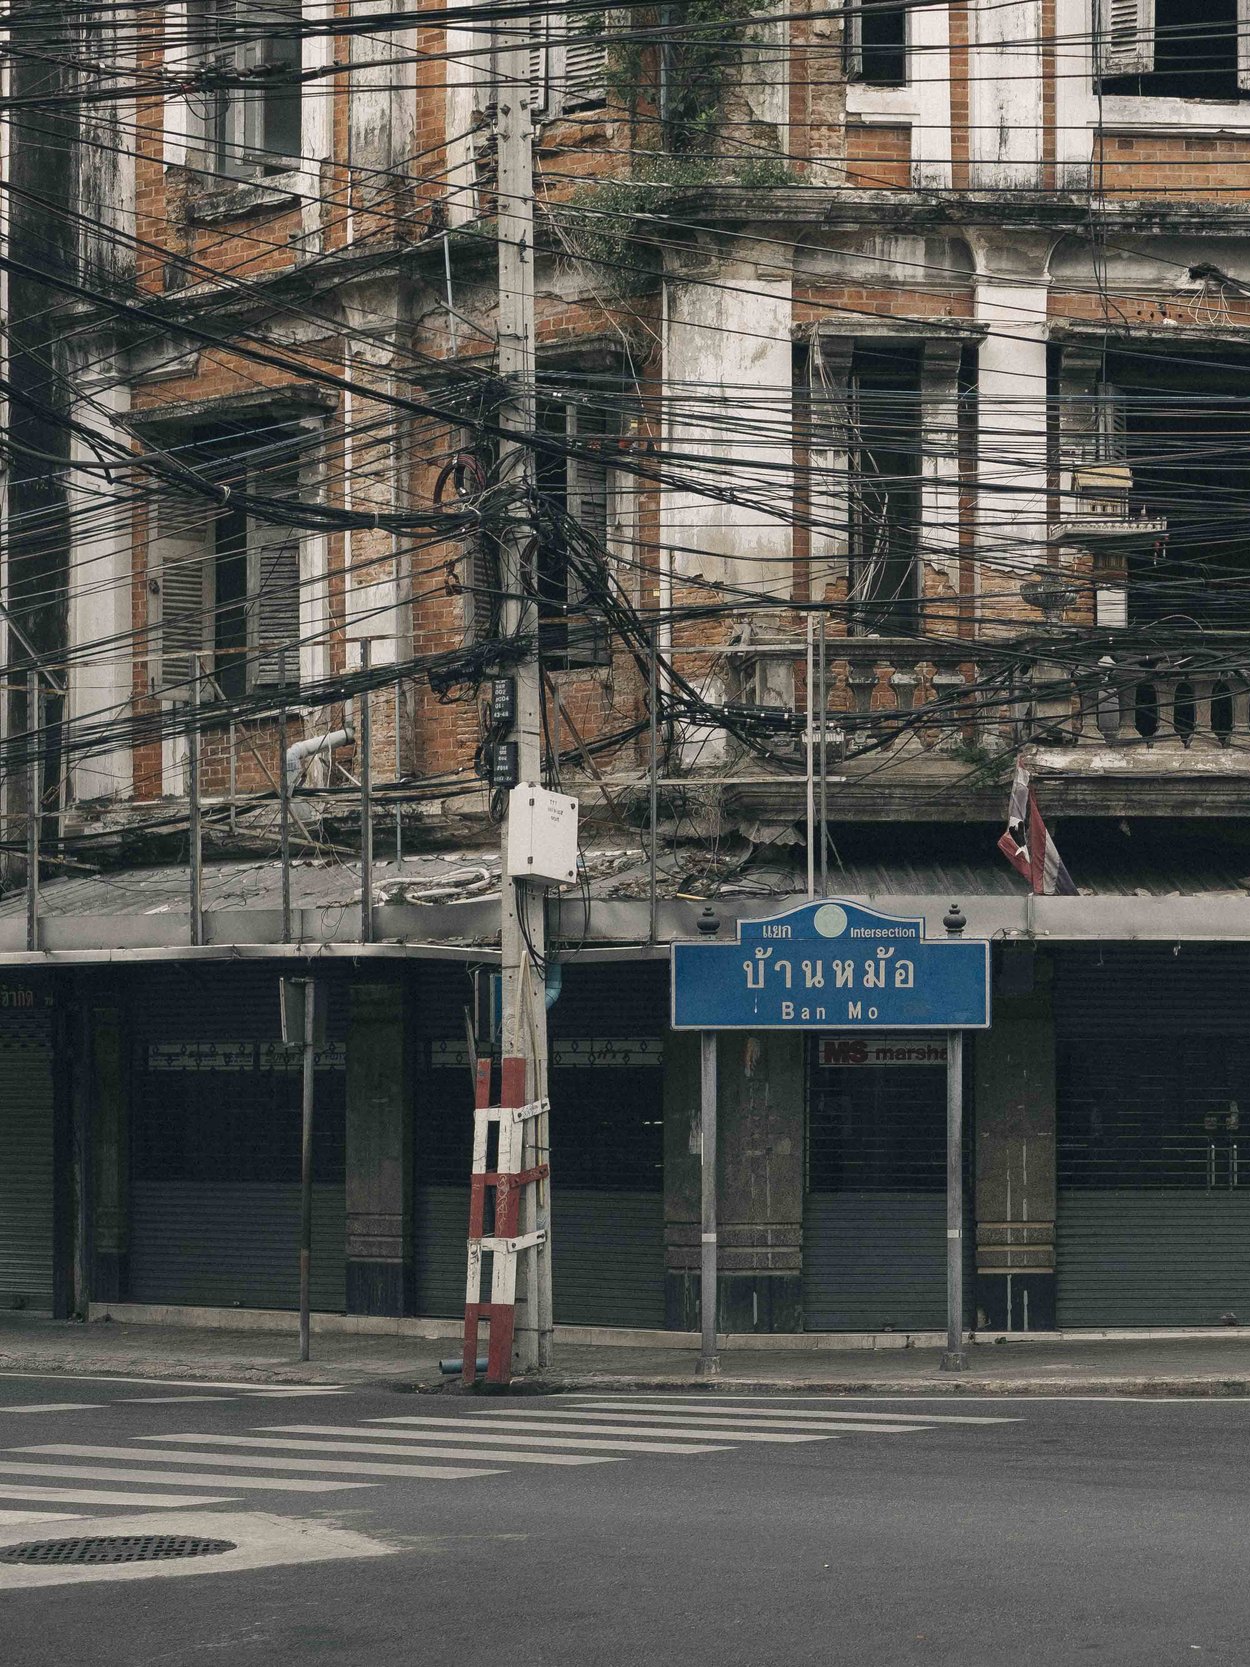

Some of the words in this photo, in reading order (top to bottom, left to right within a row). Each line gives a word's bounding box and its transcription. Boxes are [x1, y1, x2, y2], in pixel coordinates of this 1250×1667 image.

[762, 924, 792, 939] แยก
[850, 926, 916, 939] Intersection
[742, 946, 915, 989] บ้านหม้อ
[781, 1001, 826, 1020] Ban
[848, 1002, 879, 1020] Mo
